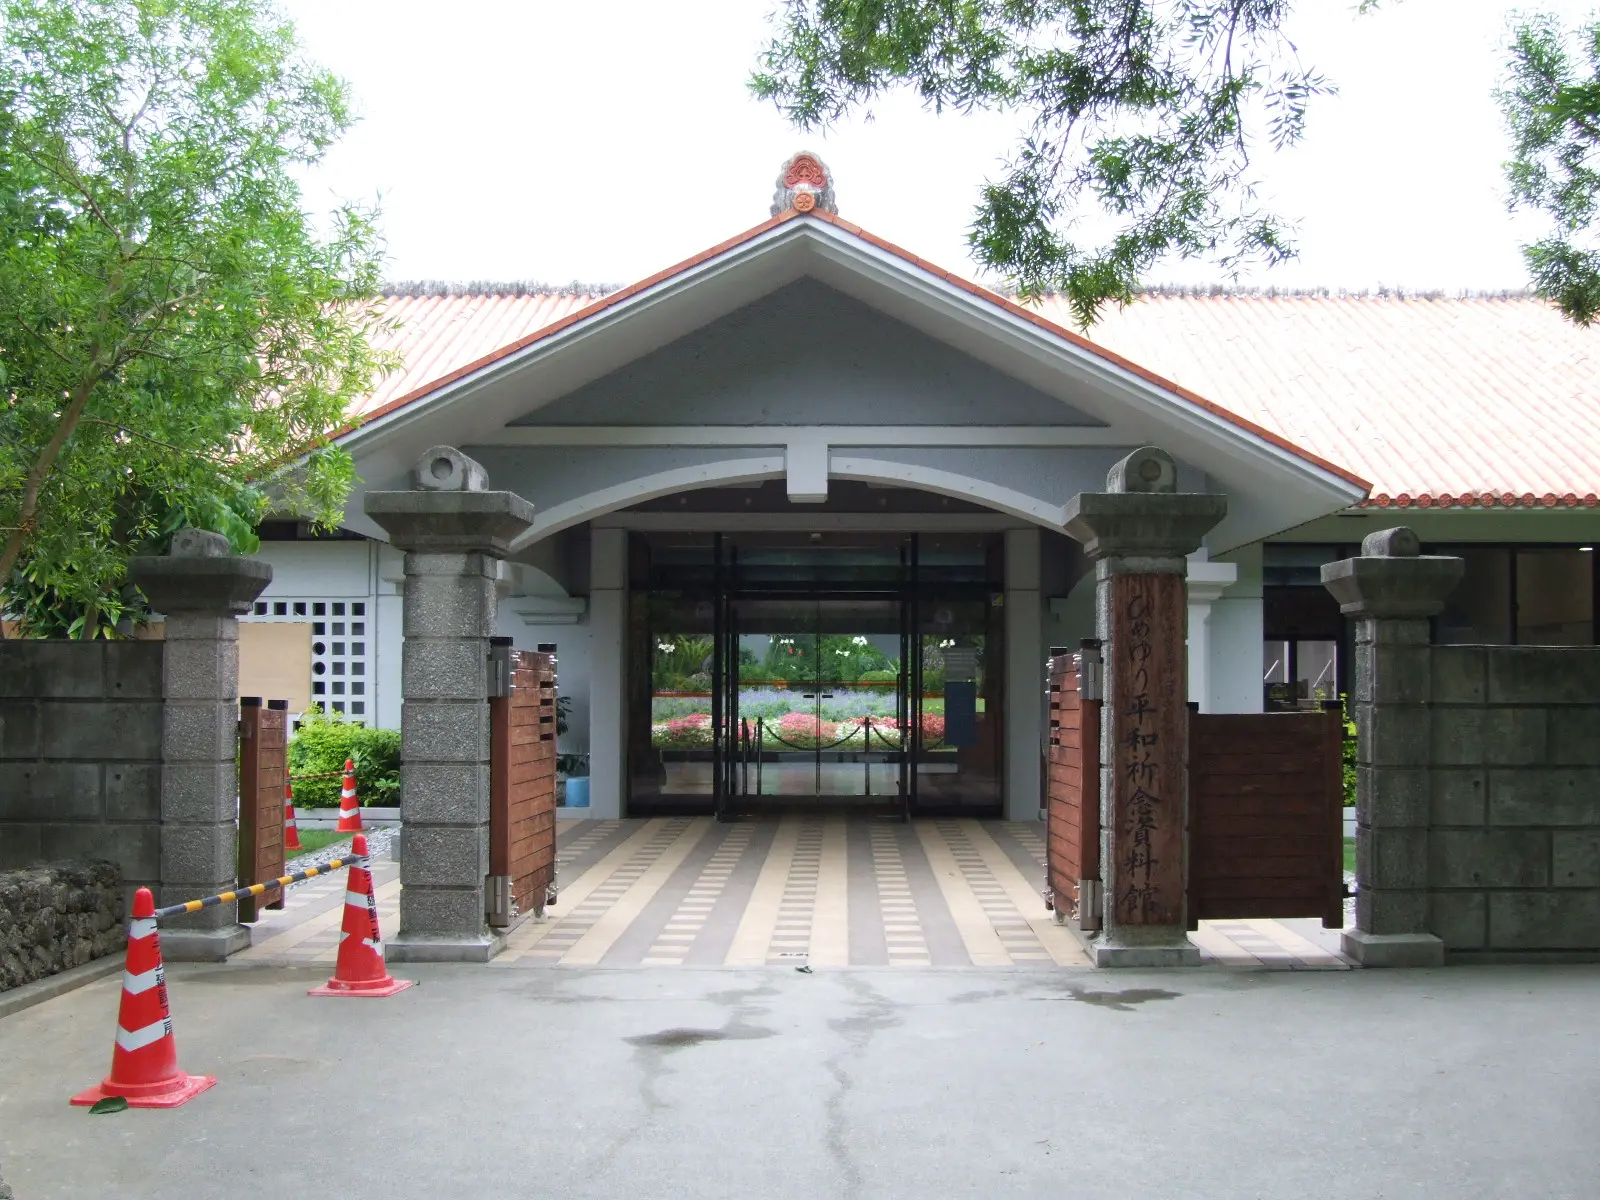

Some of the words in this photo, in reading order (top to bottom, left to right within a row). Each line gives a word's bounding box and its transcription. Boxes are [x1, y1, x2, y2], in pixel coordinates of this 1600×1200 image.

[1119, 594, 1161, 917] ひめゆり平和祈念資料館
